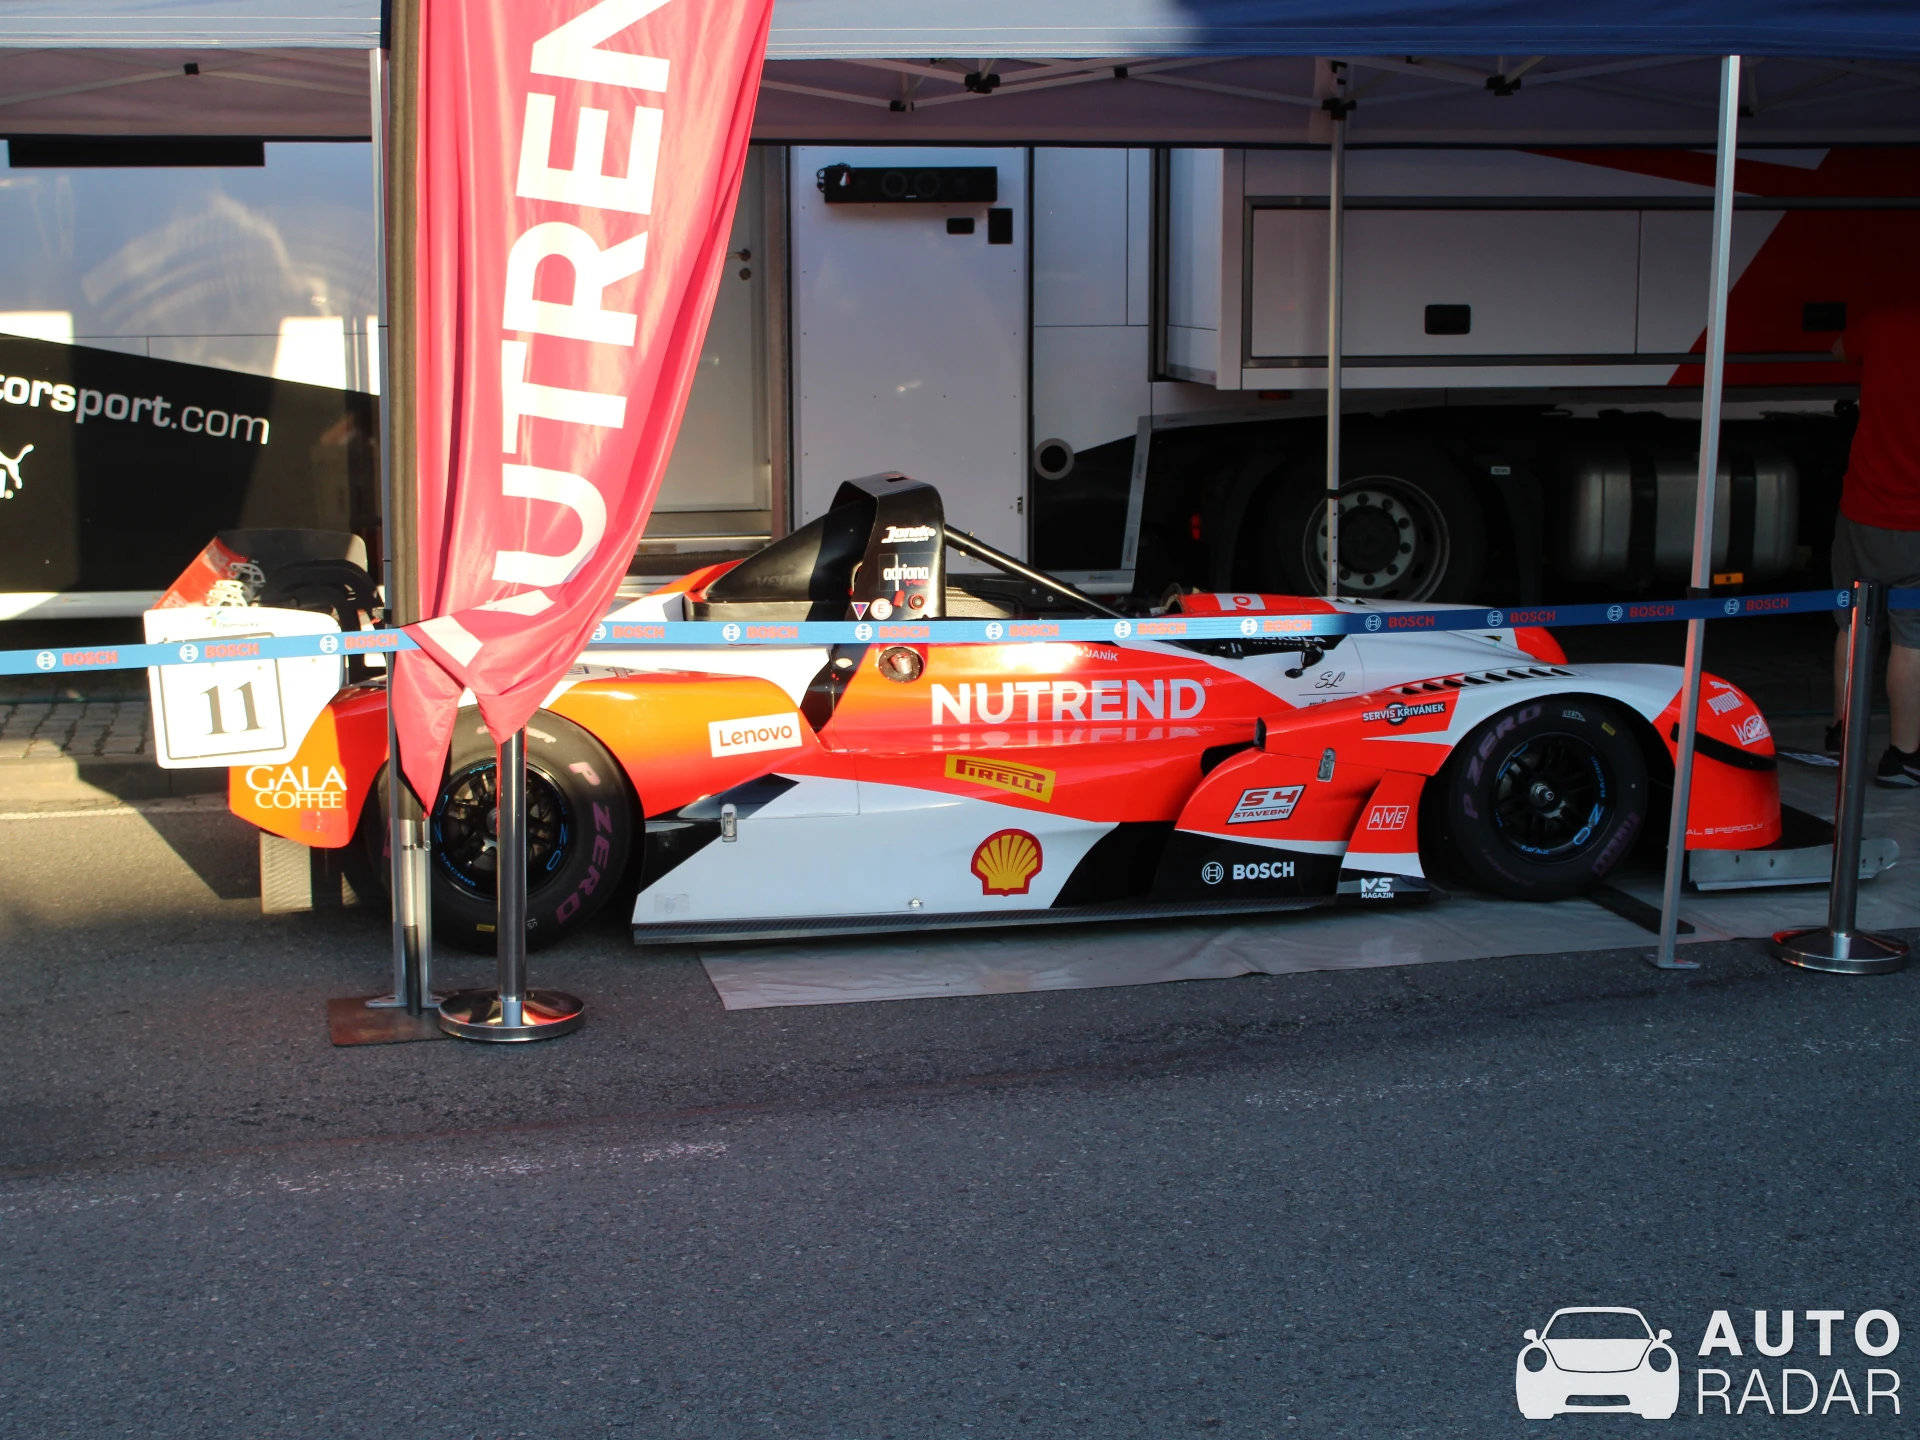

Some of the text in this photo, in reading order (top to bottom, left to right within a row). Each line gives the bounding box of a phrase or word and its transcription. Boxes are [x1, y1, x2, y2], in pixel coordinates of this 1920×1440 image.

[883, 553, 929, 591] adriana
[1629, 605, 1675, 618] BOSCH
[1745, 598, 1789, 611] BOSCH
[1388, 616, 1435, 628] BOSCH
[1510, 611, 1556, 623] BOSCH
[613, 626, 664, 639] BOSCH
[747, 626, 798, 639] BOSCH
[879, 626, 930, 638] BOSCH
[1009, 625, 1059, 638] BOSCH
[1137, 622, 1187, 635] BOSCH
[1263, 620, 1312, 633] BOSCH
[344, 634, 398, 650] BOSCH
[62, 651, 118, 666] BOSCH
[204, 643, 259, 659] BOSCH
[1086, 649, 1118, 661] JANÍK
[200, 680, 266, 736] 11
[931, 679, 1206, 725] NUTREND
[1707, 691, 1743, 716] PUMA
[1362, 703, 1445, 721] SERVIS KŘIVÁNEK
[719, 724, 793, 747] Lenovo
[1467, 702, 1543, 786] ZERO
[245, 765, 347, 791] GALA
[955, 759, 1047, 794] PIRELLI
[254, 791, 342, 809] COFFEE
[1241, 789, 1299, 807] S4
[1233, 807, 1290, 819] STAVEBNI
[1369, 807, 1407, 826] AVE
[556, 762, 612, 923] P ZERO
[1233, 861, 1295, 880] BOSCH
[1360, 878, 1394, 892] MS
